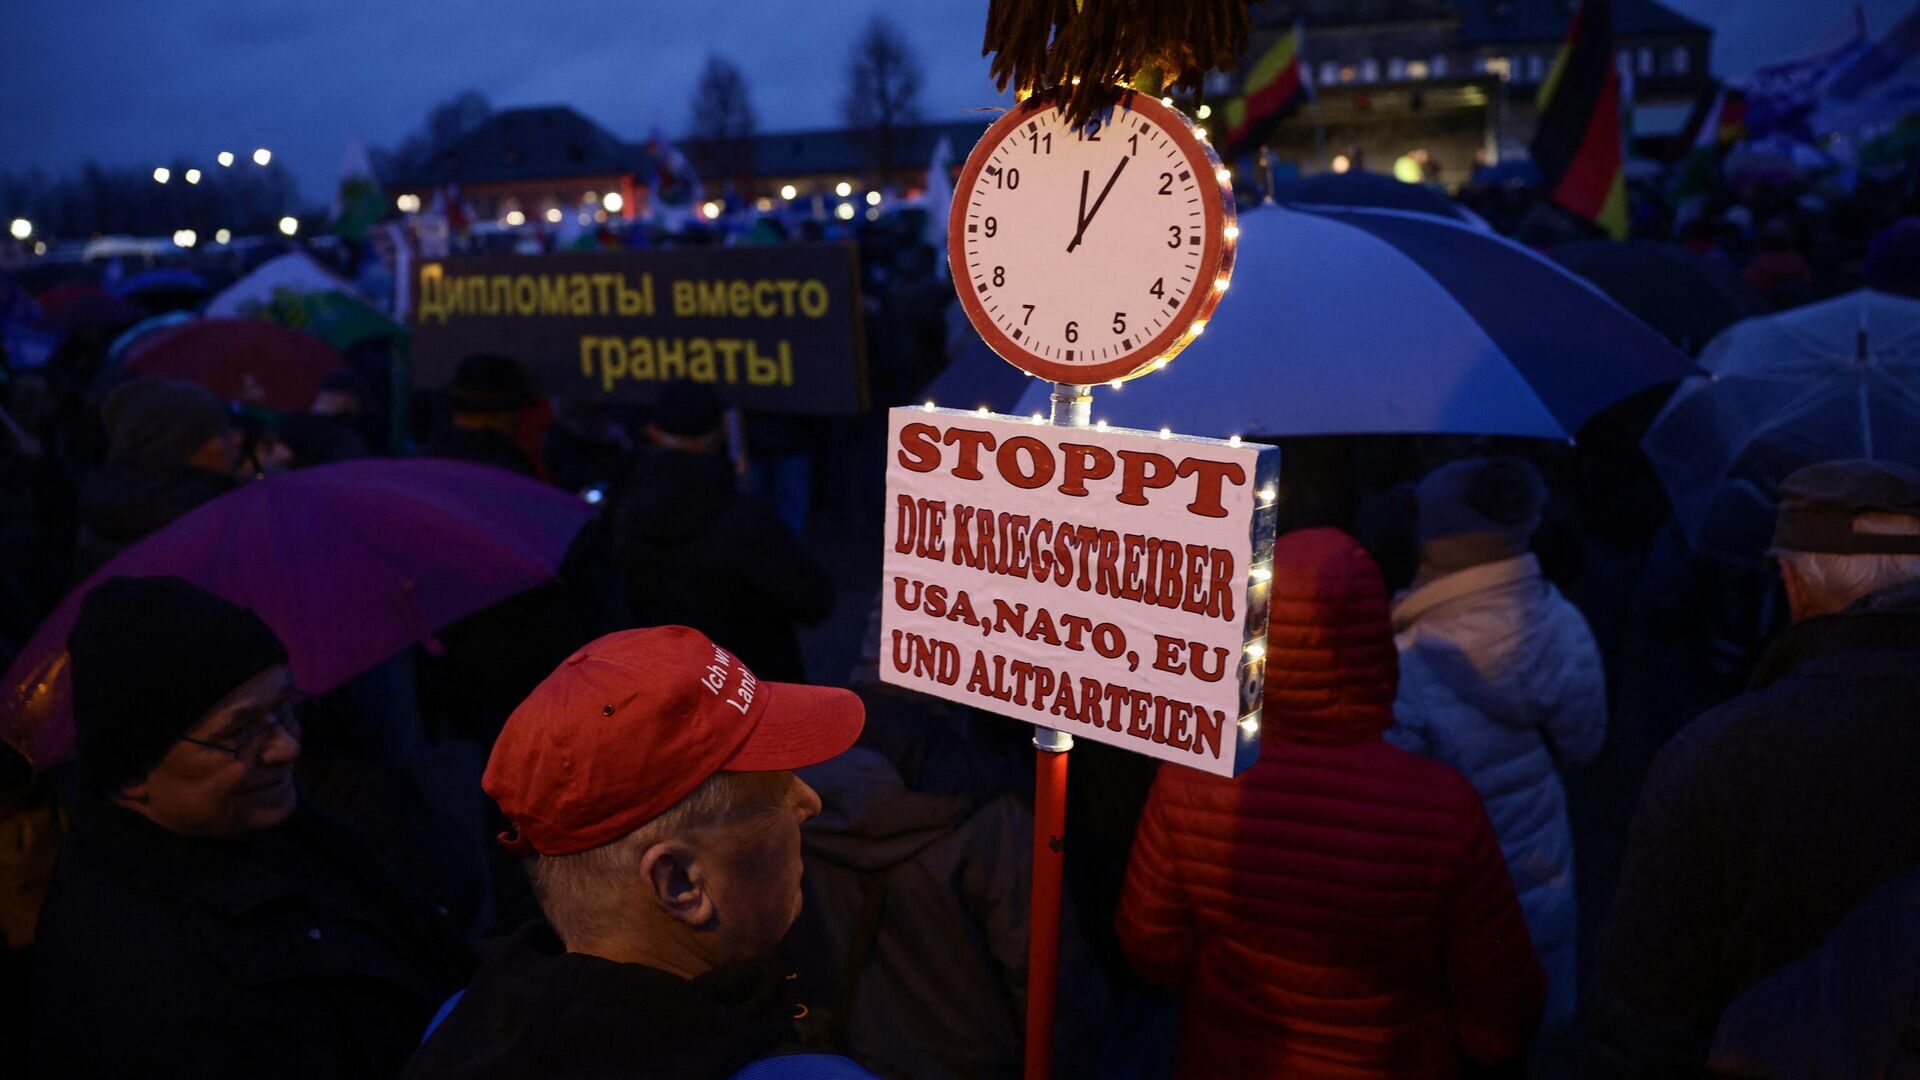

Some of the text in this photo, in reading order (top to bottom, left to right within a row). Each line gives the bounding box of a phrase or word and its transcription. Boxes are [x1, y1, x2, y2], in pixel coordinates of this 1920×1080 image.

[1029, 132, 1052, 154] 11
[1128, 134, 1138, 156] 1
[994, 168, 1019, 189] 10
[1158, 173, 1173, 195] 2
[984, 217, 997, 238] 9
[1167, 226, 1182, 248] 3
[992, 266, 1005, 287] 8
[673, 277, 830, 320] вместо
[1149, 278, 1165, 299] 4
[1022, 304, 1035, 325] 7
[1112, 312, 1126, 334] 5
[1064, 321, 1079, 343] 6
[579, 334, 794, 392] гранаты
[898, 422, 1246, 518] STOPPT
[896, 494, 1234, 622] DIE KRIEGSTREIBER
[1152, 634, 1230, 683] EU
[701, 664, 728, 696] Ich
[892, 629, 1225, 760] UND ALTPARTEIEN
